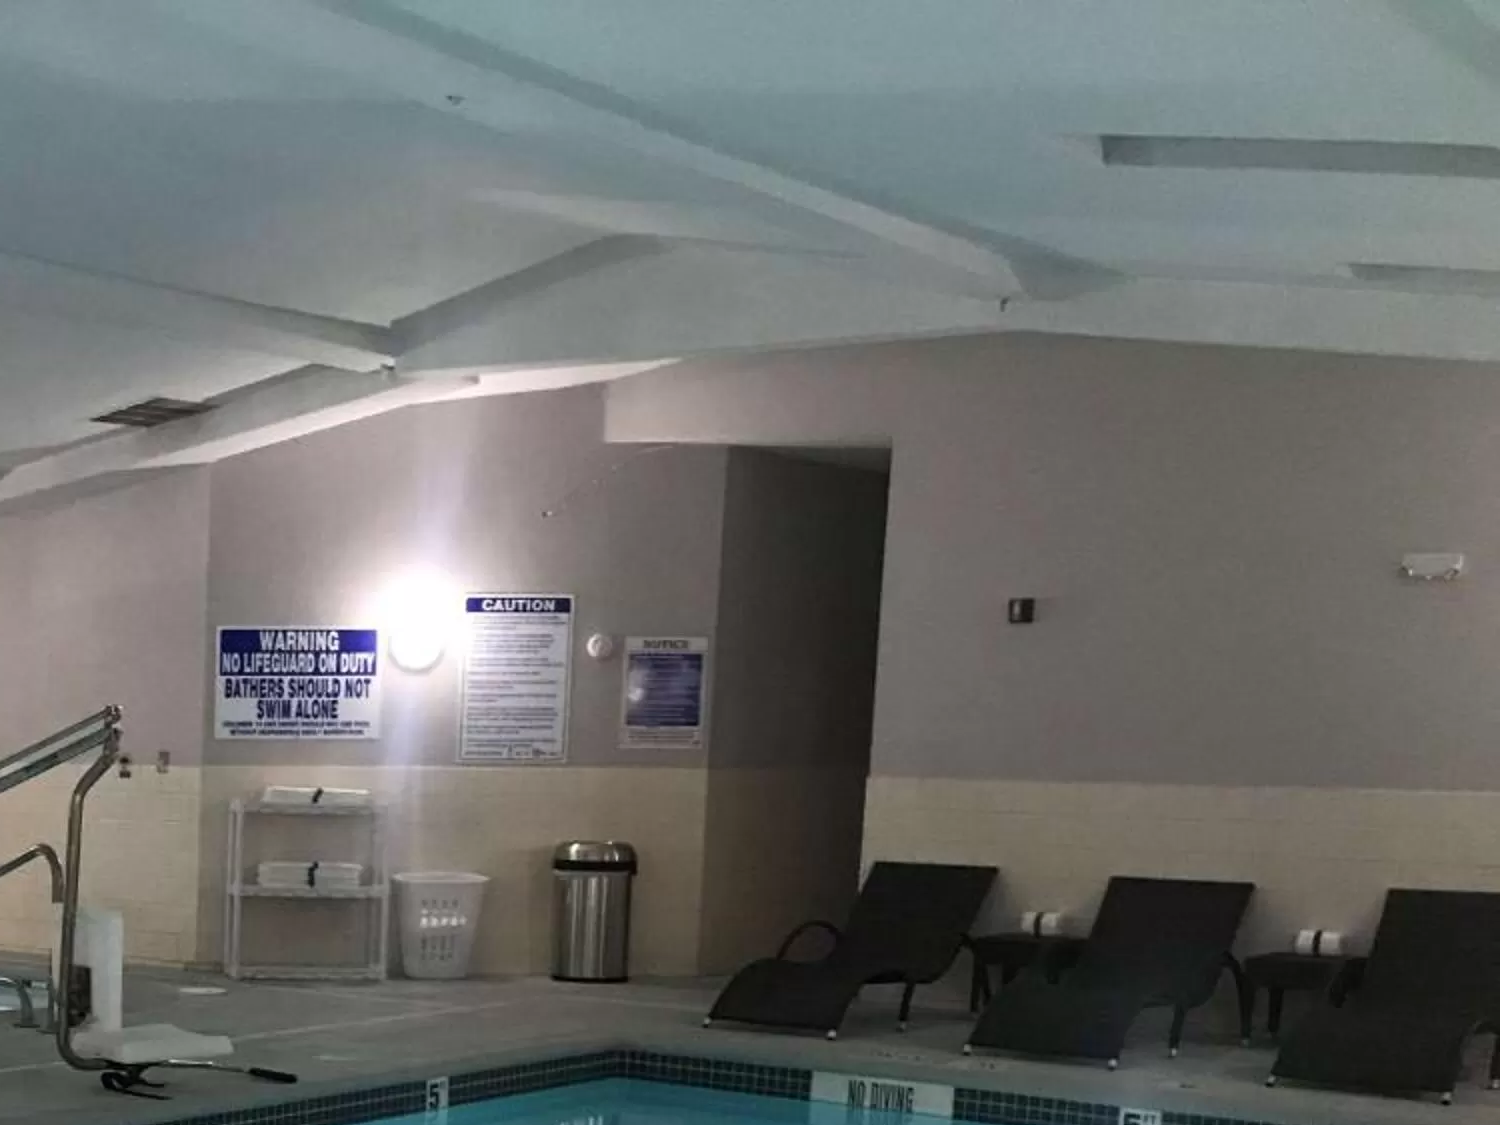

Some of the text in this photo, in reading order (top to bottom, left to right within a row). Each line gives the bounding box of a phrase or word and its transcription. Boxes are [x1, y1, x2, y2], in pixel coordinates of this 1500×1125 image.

[482, 599, 555, 611] CAUTION
[259, 631, 340, 651] WARNING
[222, 653, 375, 673] NO LIFEGUARD ON DUTY
[224, 678, 371, 699] BATHERS SHOULD NOT
[257, 699, 339, 719] SWIM ALONE
[848, 1079, 914, 1114] NO DIVING
